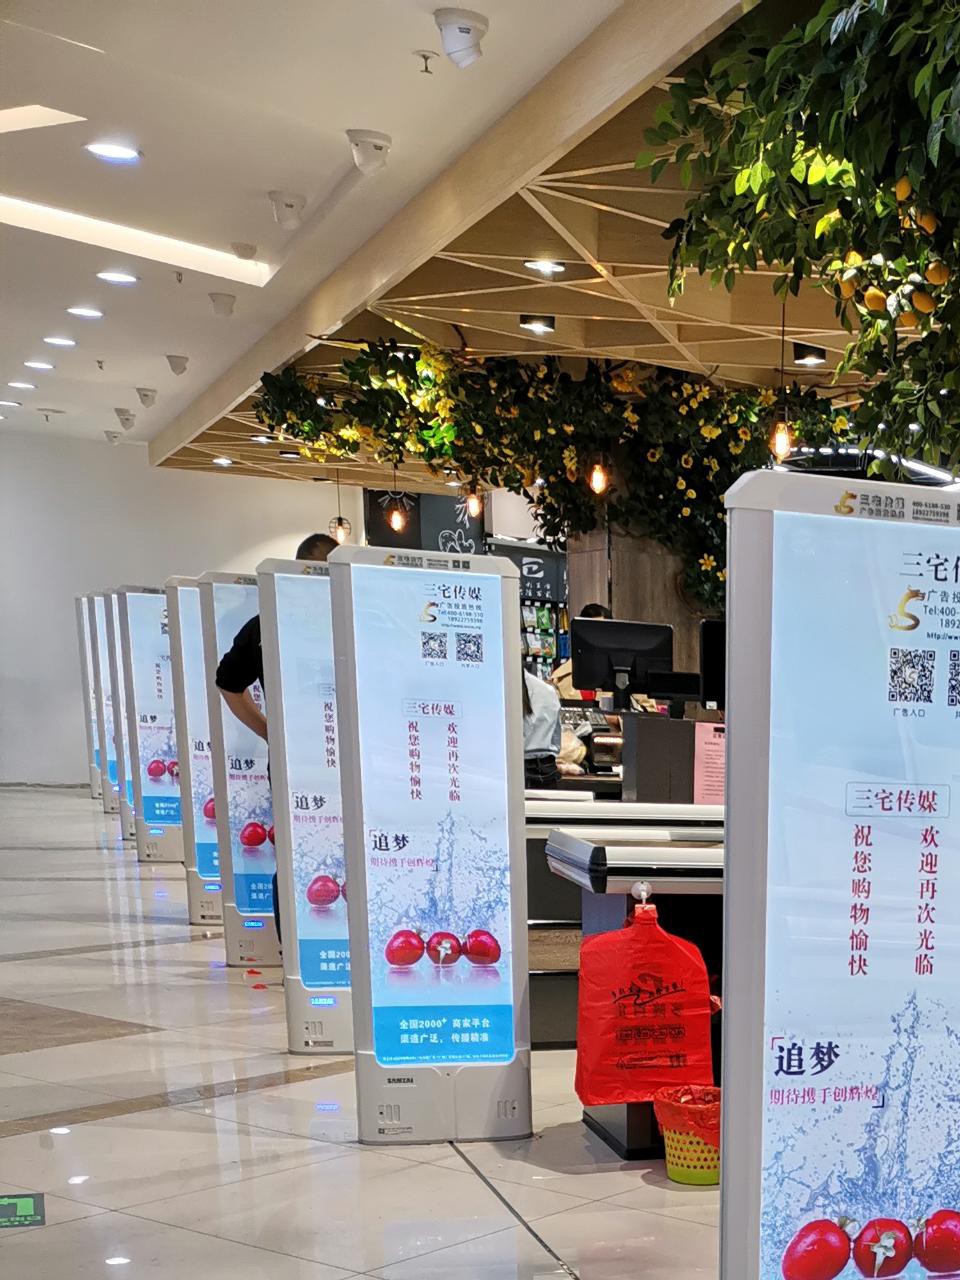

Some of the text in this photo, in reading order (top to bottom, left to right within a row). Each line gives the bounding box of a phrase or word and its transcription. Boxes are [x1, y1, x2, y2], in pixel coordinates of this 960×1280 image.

[424, 583, 482, 601] 三宅传媒
[405, 701, 456, 716] 三宅传媒
[407, 719, 423, 801] 祝您购物愉快
[447, 721, 461, 801] 欢迎再次光临
[852, 788, 939, 814] 三宅传媒
[848, 823, 874, 977] 祝您购物愉快
[914, 825, 940, 977] 欢迎再次光临
